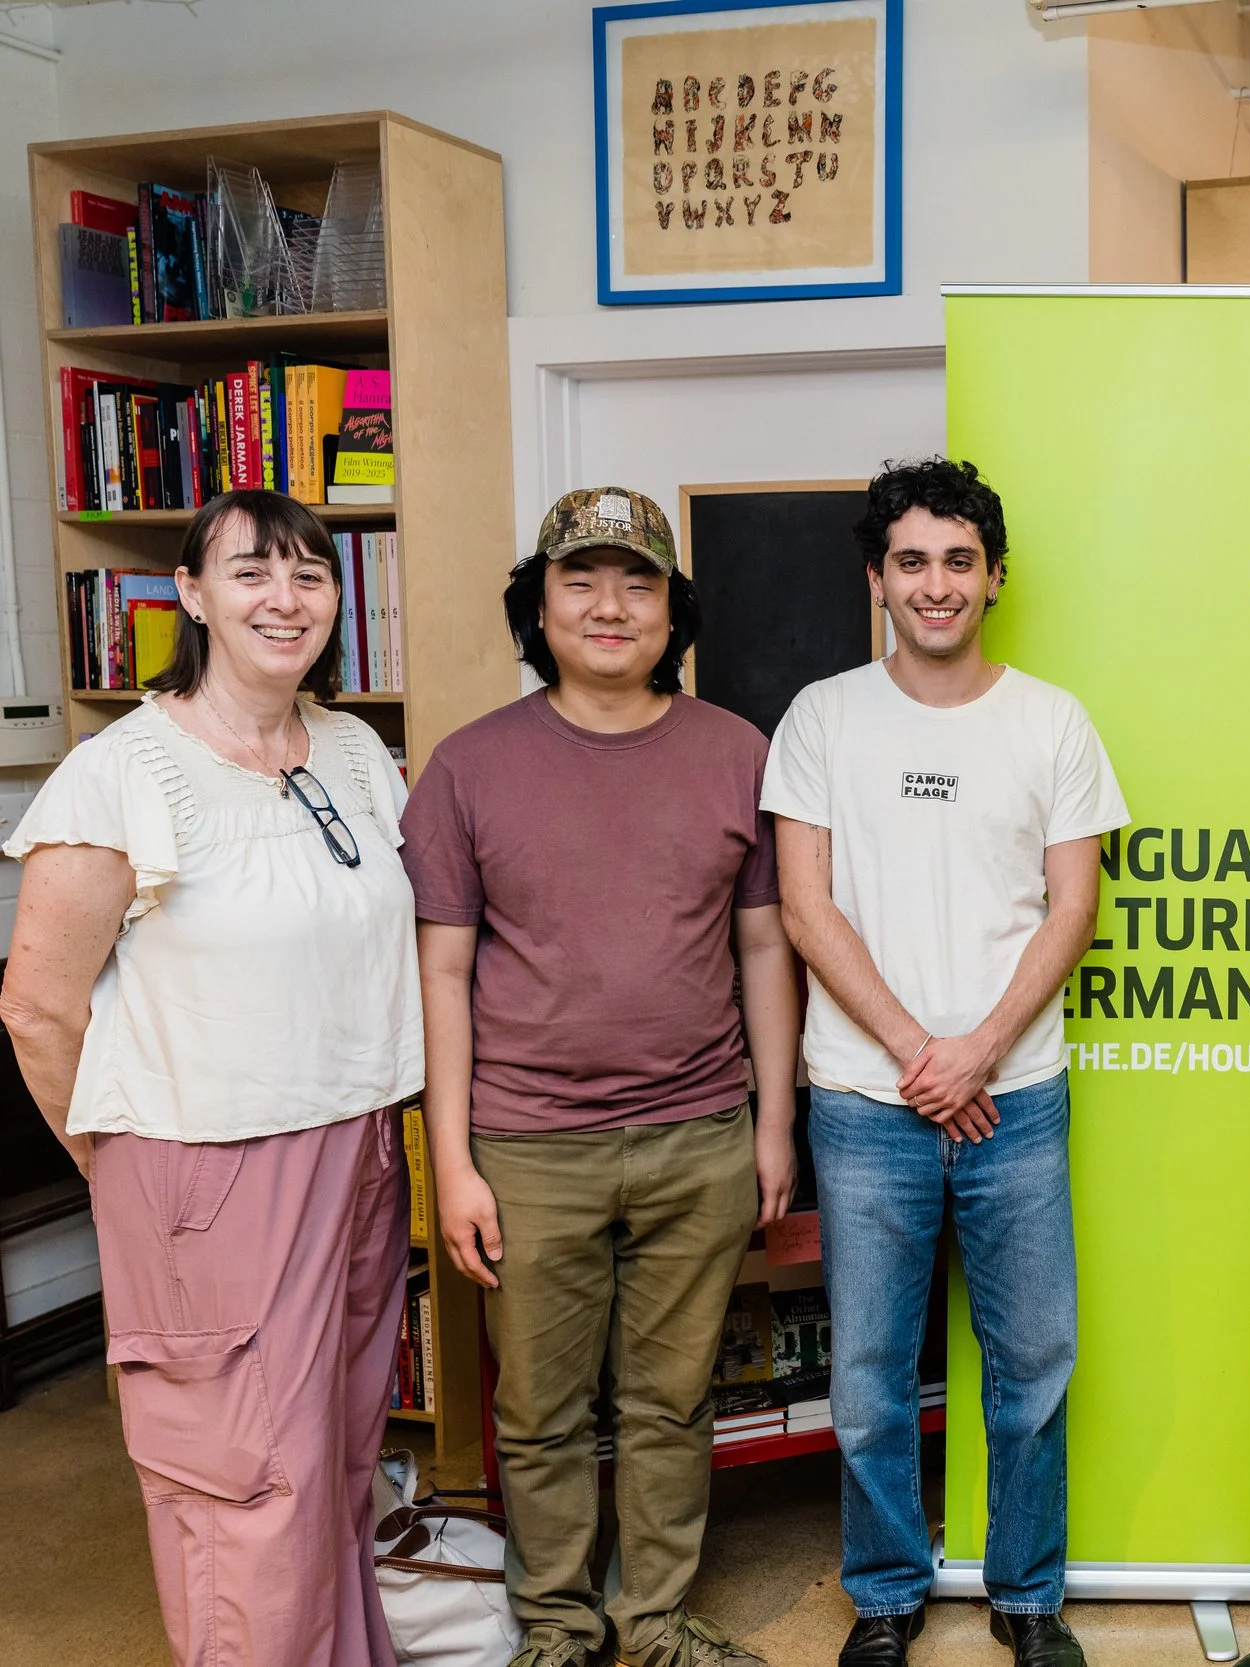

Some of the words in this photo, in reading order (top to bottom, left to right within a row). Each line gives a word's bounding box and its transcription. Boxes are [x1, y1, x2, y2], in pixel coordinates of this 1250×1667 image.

[248, 366, 258, 394] SPIKE
[233, 378, 246, 421] DEREK
[250, 395, 258, 412] LEE
[260, 390, 274, 456] LITTLE
[307, 406, 316, 434] corpo
[370, 432, 394, 450] NIGH
[236, 424, 248, 484] JARMAN
[287, 436, 295, 470] politico
[308, 436, 316, 477] veggente
[343, 457, 360, 466] Film
[596, 520, 634, 532] JSTOR
[146, 584, 174, 596] LAND
[905, 774, 956, 787] CAMOU
[904, 786, 948, 799] FLAGE
[798, 1295, 815, 1303] The
[784, 1312, 830, 1324] Almanac
[791, 1304, 820, 1314] Other
[424, 1304, 432, 1334] ZEROX
[425, 1338, 434, 1382] MACHINE
